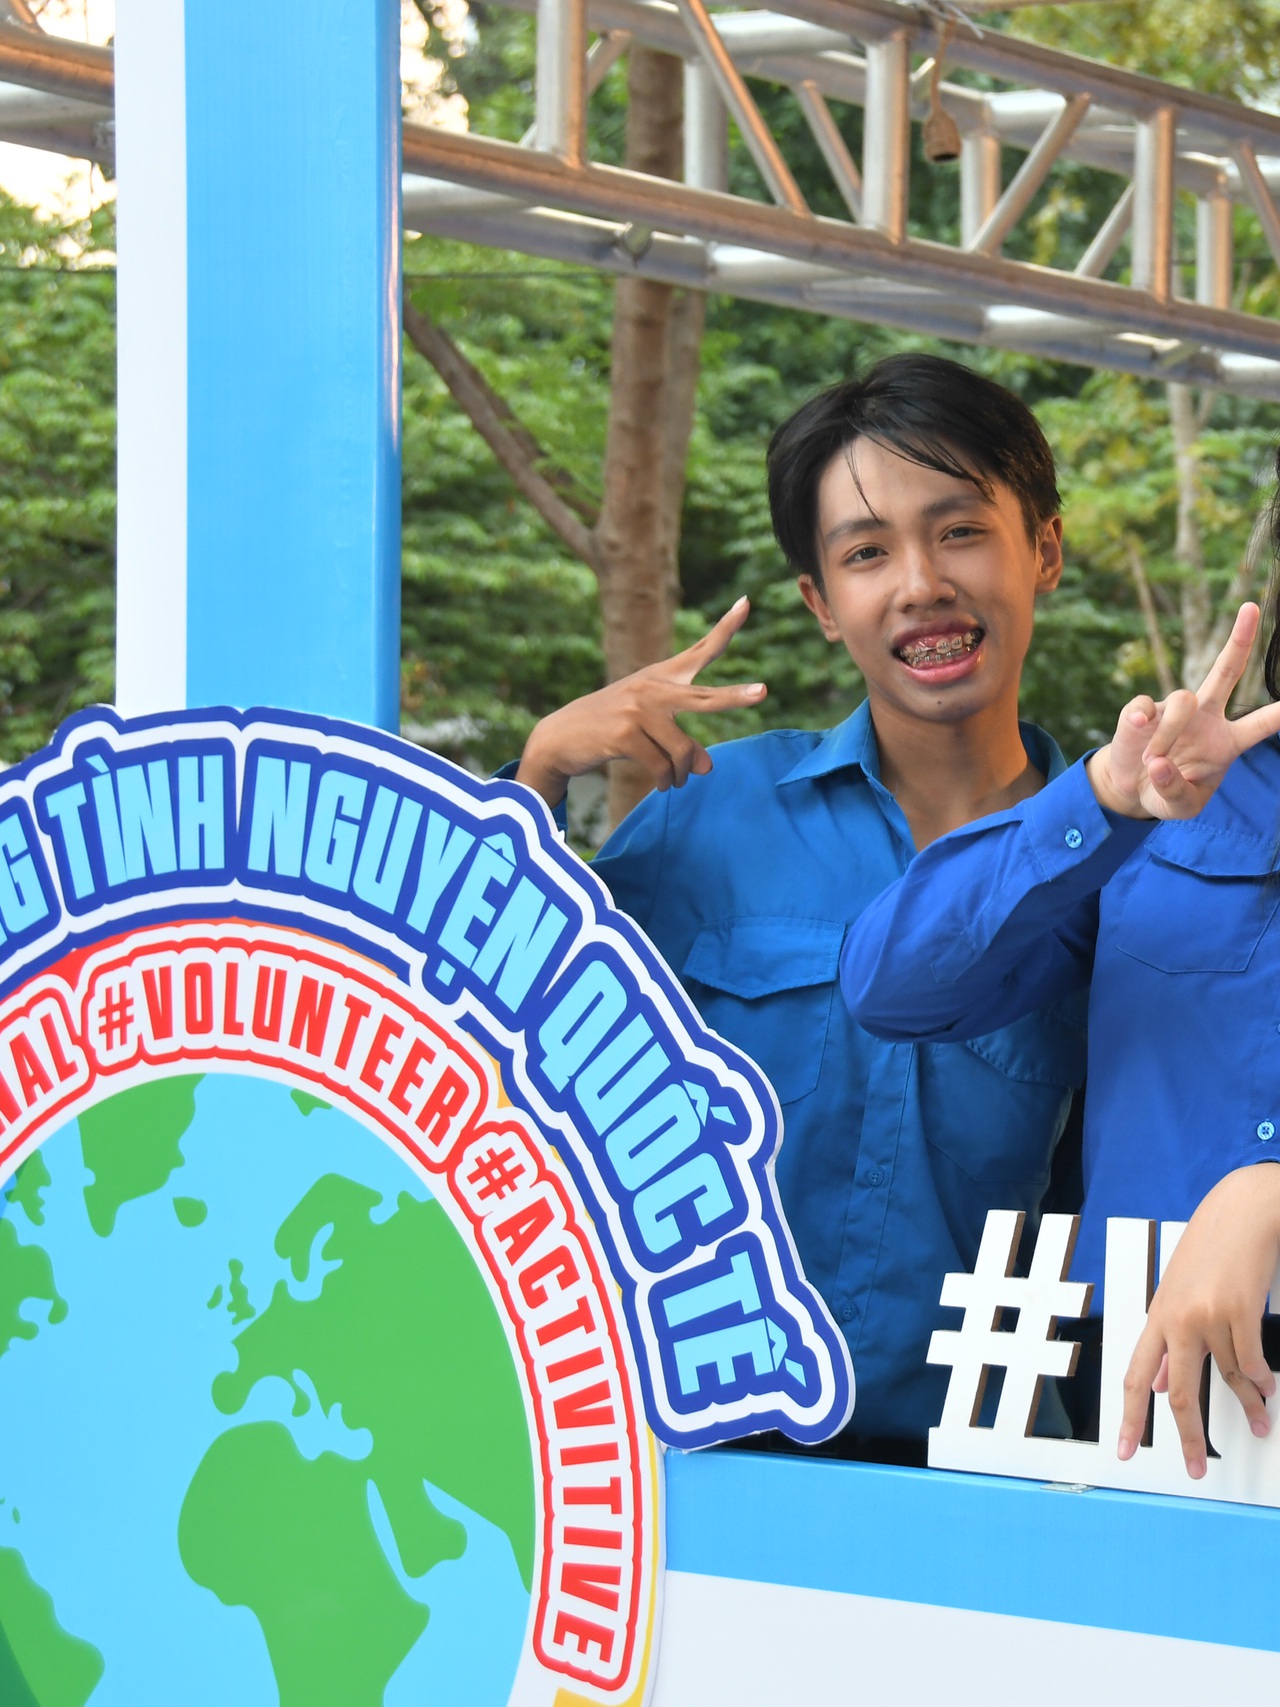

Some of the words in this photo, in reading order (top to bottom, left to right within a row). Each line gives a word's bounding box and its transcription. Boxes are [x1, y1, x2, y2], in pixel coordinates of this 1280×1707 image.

[0, 812, 50, 944] G
[46, 754, 225, 900] TÌNH
[247, 756, 568, 1014] NGUYỆN
[538, 960, 737, 1254] QUỐC
[662, 1251, 807, 1396] TẾ
[98, 962, 469, 1147] #VOLUNTEER
[467, 1147, 623, 1664] #ACTIVITIVE
